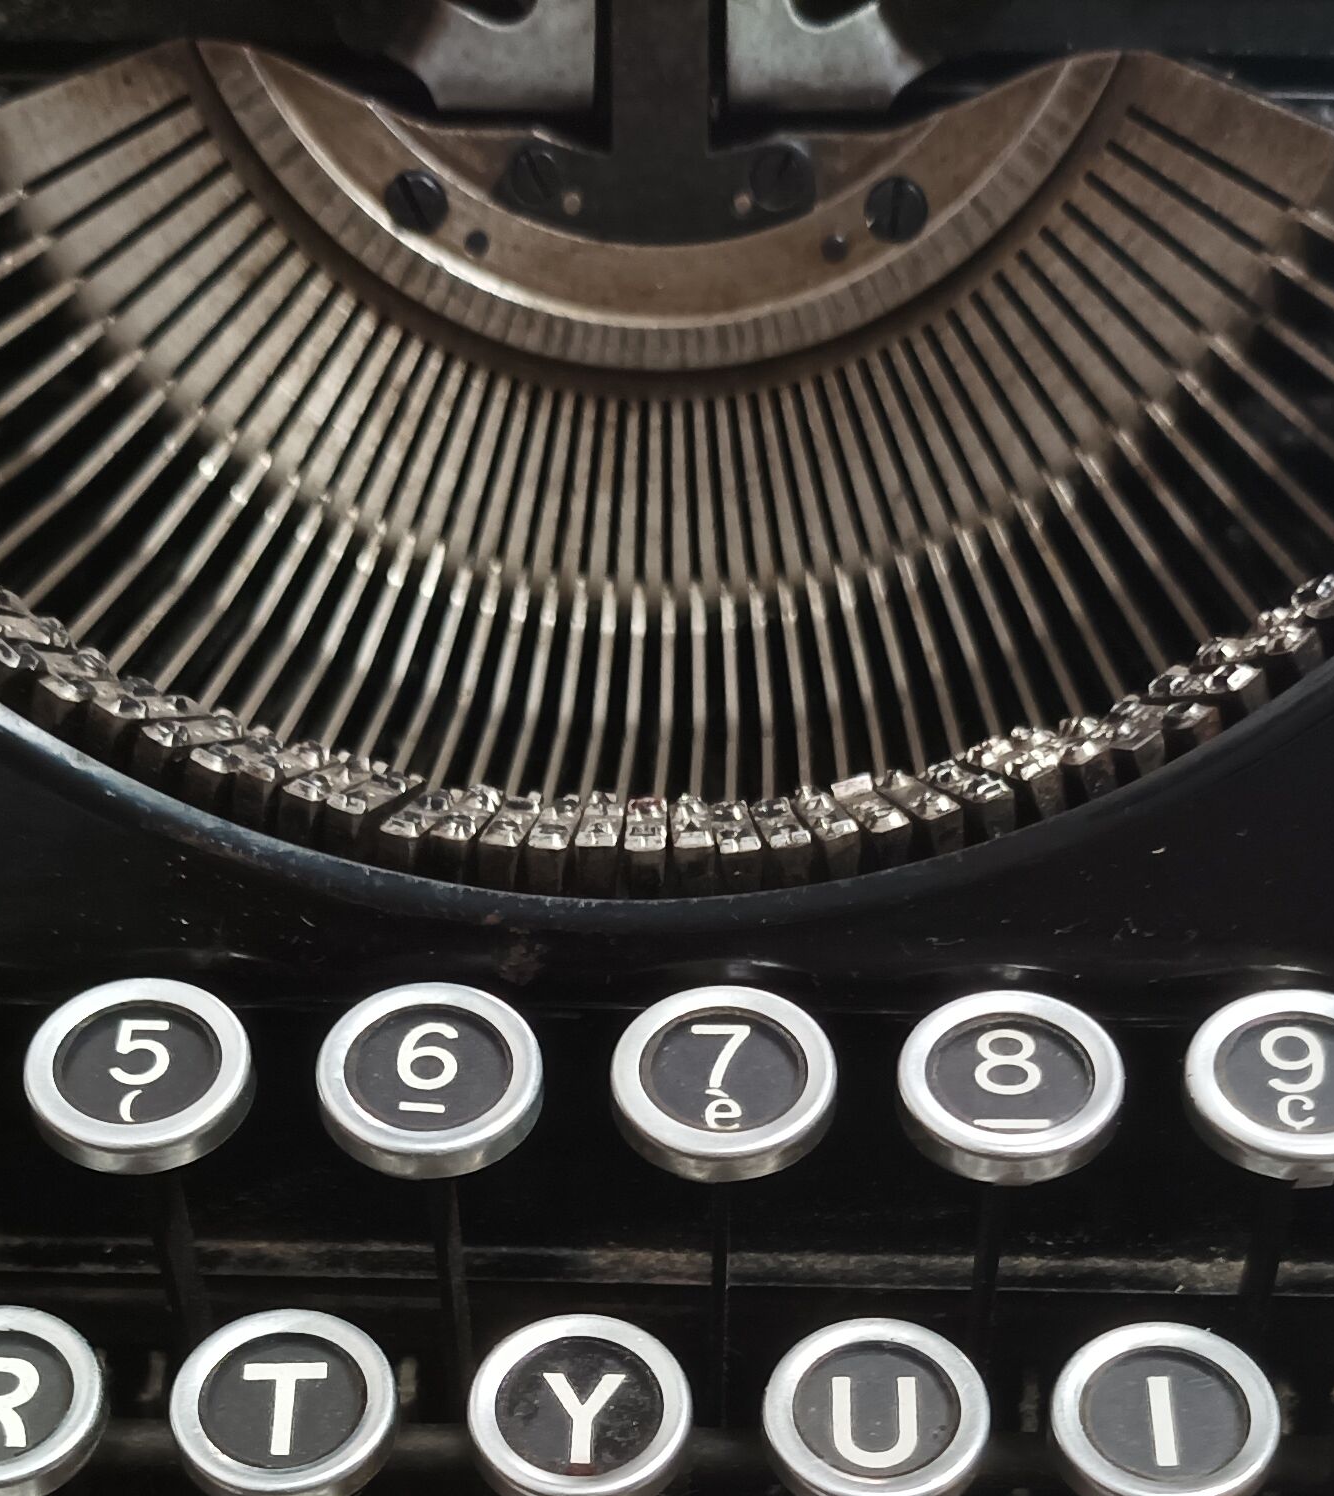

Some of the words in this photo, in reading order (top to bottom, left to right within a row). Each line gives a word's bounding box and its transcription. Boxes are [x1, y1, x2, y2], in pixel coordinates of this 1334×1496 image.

[108, 1020, 170, 1085] 5
[396, 1022, 458, 1091] 6
[691, 1024, 751, 1088] 7
[974, 1029, 1037, 1094] 8
[1260, 1027, 1324, 1093] 9
[119, 1089, 136, 1122] (
[703, 1087, 742, 1129] è
[243, 1362, 328, 1456] T
[543, 1372, 626, 1464] Y
[832, 1376, 917, 1469] U
[1146, 1376, 1179, 1467] I
